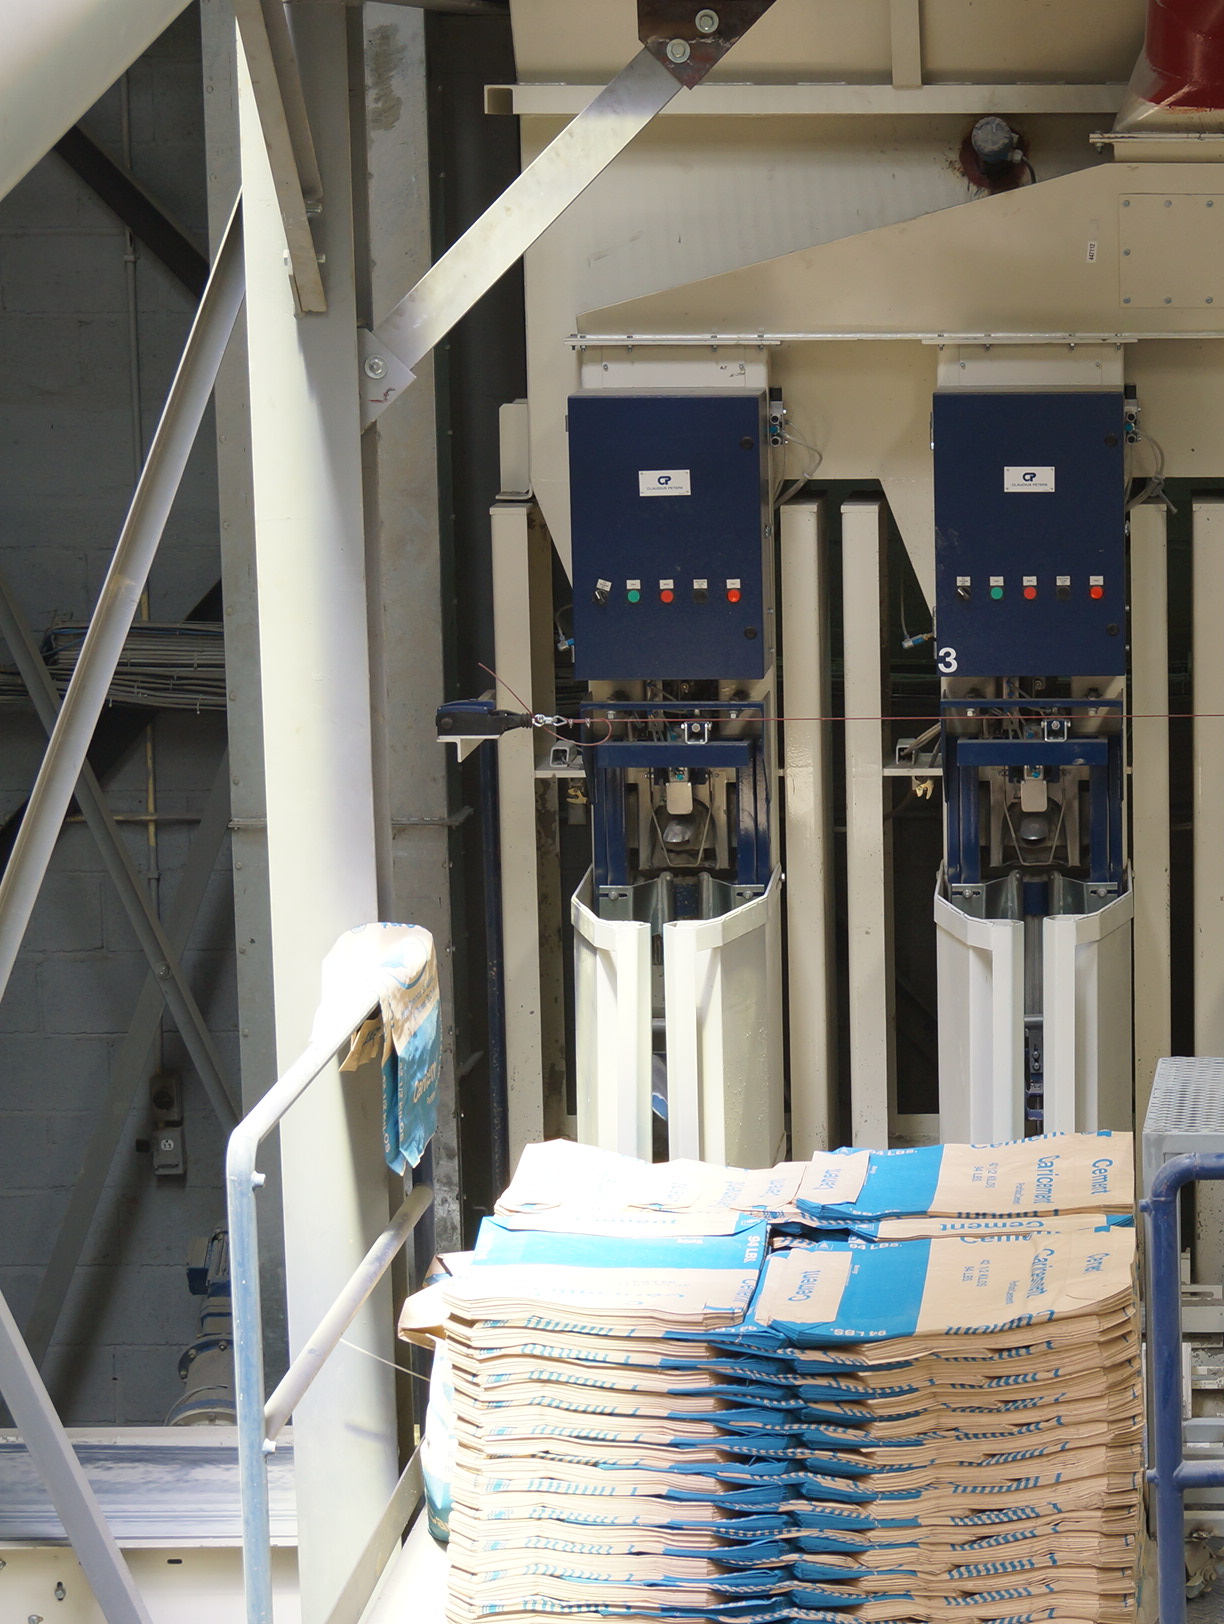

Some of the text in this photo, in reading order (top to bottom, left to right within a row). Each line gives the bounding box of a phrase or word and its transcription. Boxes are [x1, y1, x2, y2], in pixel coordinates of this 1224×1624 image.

[938, 648, 958, 673] 3
[1033, 1155, 1061, 1204] Caricement
[1091, 1158, 1114, 1195] Cement
[940, 1220, 1045, 1232] Cement
[747, 1236, 761, 1247] 94
